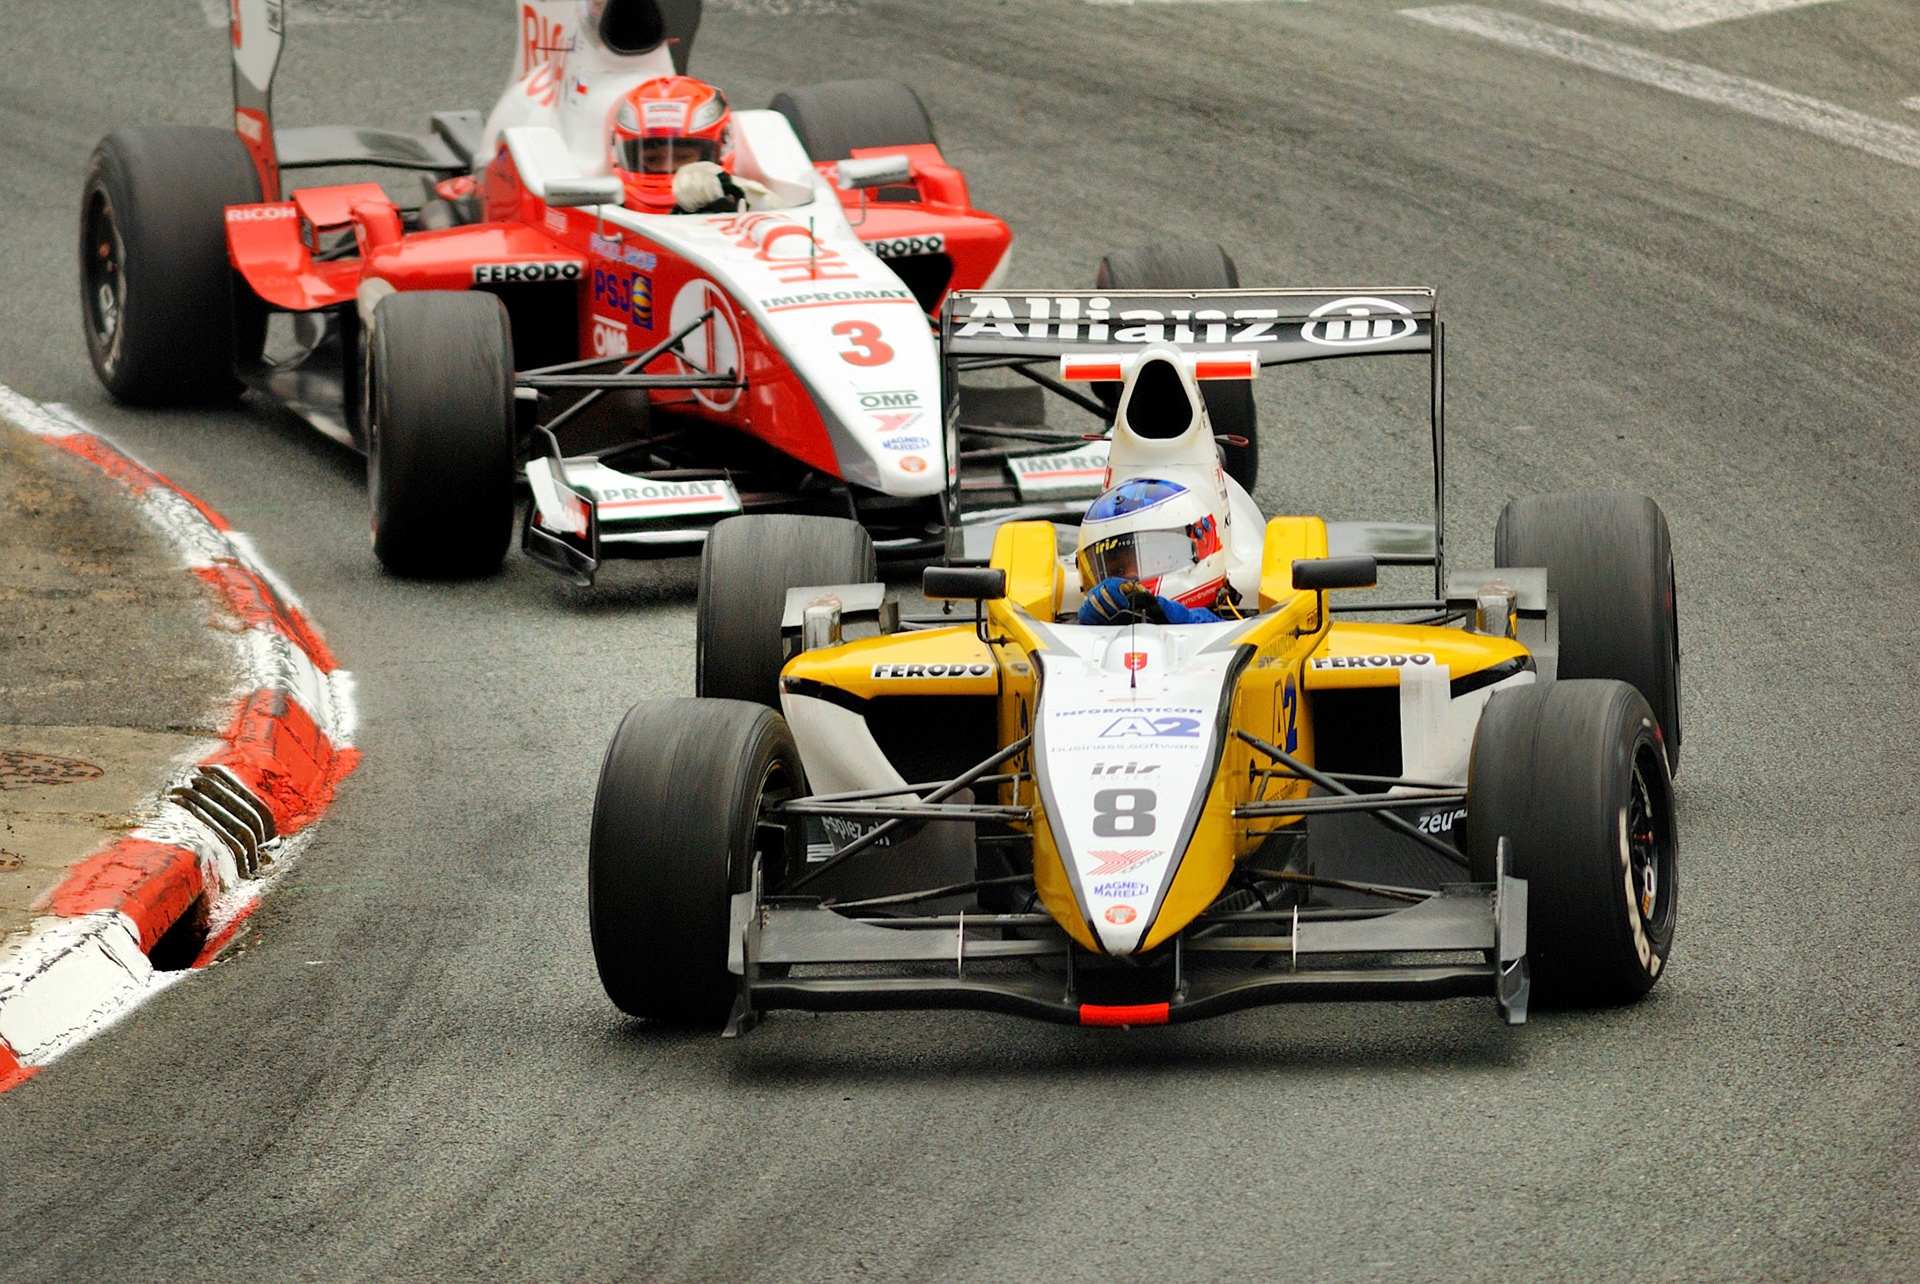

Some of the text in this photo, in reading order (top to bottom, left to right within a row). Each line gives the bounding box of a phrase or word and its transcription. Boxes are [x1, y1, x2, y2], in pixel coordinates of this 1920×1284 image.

[225, 206, 298, 221] RICOH
[863, 235, 942, 258] RODO
[475, 263, 580, 282] FERODO
[595, 269, 630, 312] PSJ
[761, 289, 911, 308] IMPROMAT
[954, 297, 1278, 343] Allianz
[832, 319, 895, 367] 3
[860, 393, 919, 408] OMP
[597, 481, 717, 502] PROMAT
[1095, 538, 1118, 554] iris
[874, 663, 991, 678] FERODO
[1315, 654, 1432, 669] FERODO
[1055, 706, 1203, 718] INFORMATICON
[1098, 716, 1201, 738] A2
[1091, 761, 1161, 776] iris
[1092, 788, 1158, 838] 8
